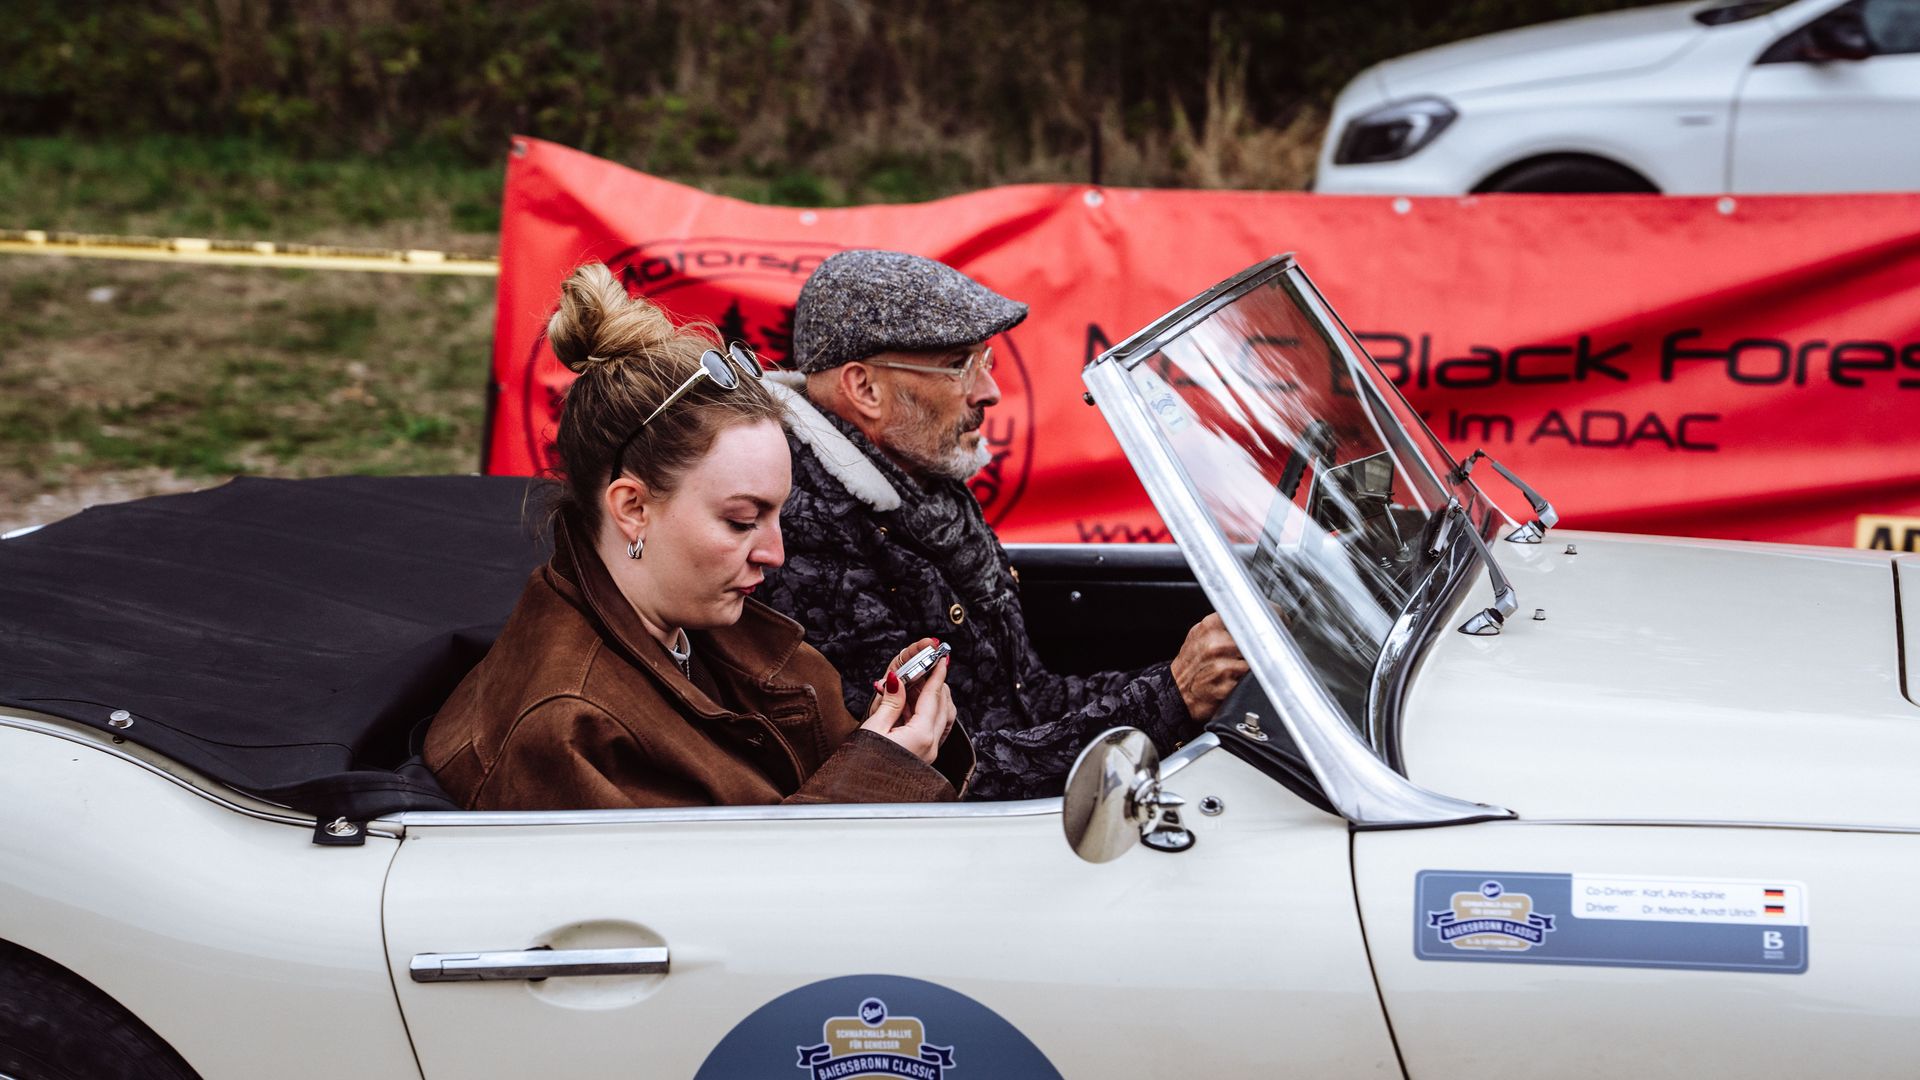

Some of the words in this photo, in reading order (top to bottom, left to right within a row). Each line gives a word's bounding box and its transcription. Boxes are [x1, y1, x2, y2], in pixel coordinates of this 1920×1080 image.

[1528, 410, 1719, 452] ADAC
[1585, 885, 1637, 898] Co-Driver:
[1667, 889, 1726, 901] Ann-Sophie
[1585, 902, 1619, 914] Driver:
[1444, 920, 1503, 939] BAIERSBRONN
[1503, 922, 1540, 941] CLASSIC
[1763, 931, 1784, 949] B
[818, 1057, 889, 1080] BAIERSBRONN
[892, 1058, 936, 1080] CLASSIC
